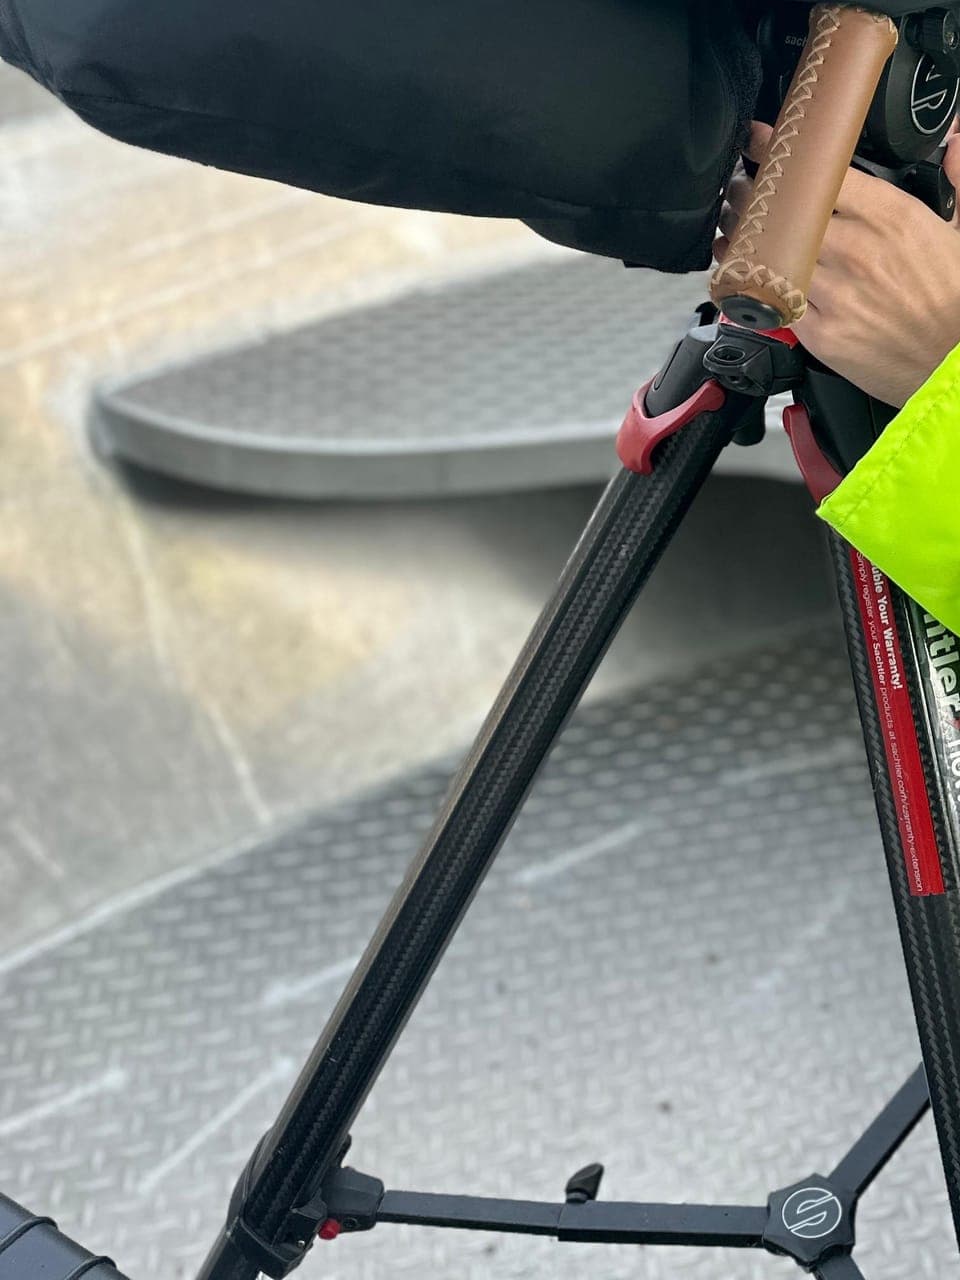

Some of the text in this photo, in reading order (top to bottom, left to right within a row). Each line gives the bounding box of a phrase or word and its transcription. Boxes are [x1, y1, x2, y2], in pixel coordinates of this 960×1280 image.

[856, 551, 867, 583] Simply
[862, 584, 874, 618] register
[867, 620, 879, 642] your
[871, 562, 904, 690] uble Your Warranty!
[872, 642, 886, 687] Sachtler
[880, 687, 894, 729] products
[888, 730, 897, 741] at
